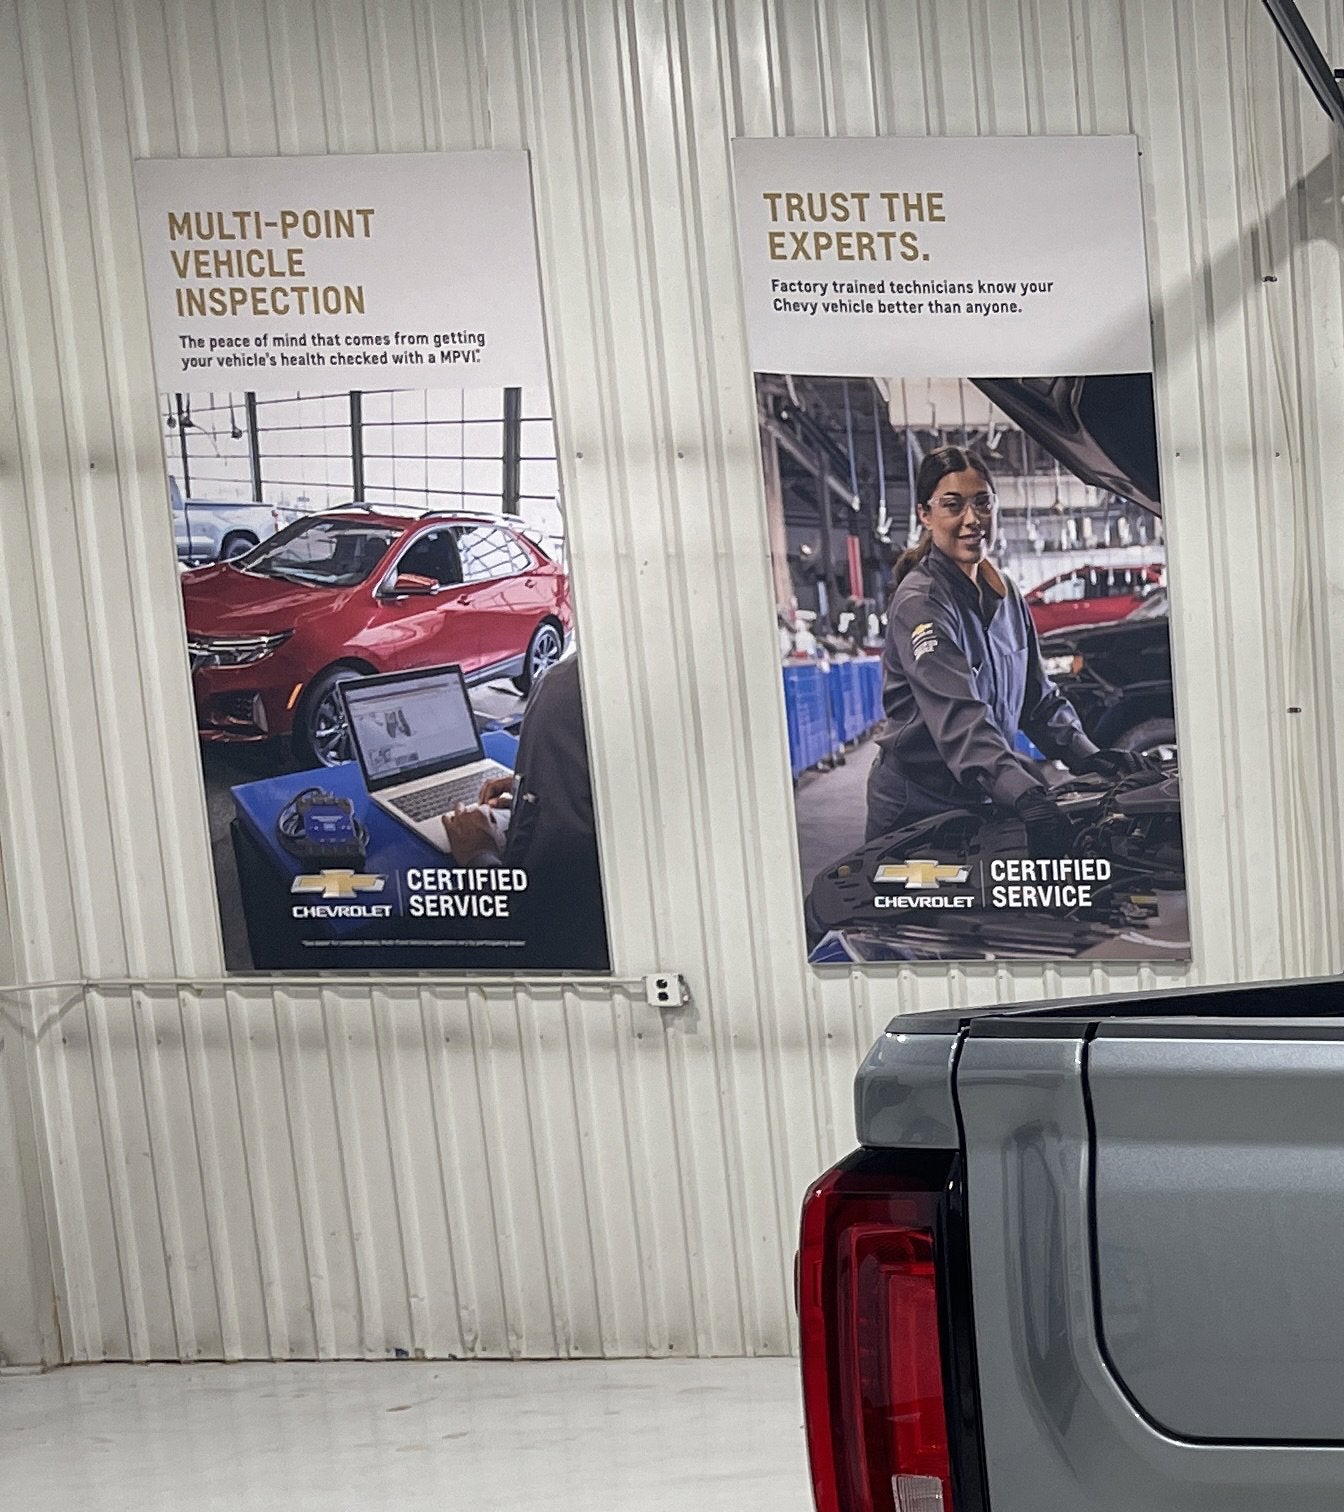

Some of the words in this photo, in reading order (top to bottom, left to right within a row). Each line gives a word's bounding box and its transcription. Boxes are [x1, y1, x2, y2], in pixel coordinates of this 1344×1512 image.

[762, 191, 870, 223] TRUST
[880, 191, 946, 222] THE
[167, 208, 376, 241] MULTI-POINT
[767, 231, 931, 262] EXPERTS.
[170, 249, 305, 279] VEHICLE
[771, 278, 828, 296] Factory
[832, 278, 885, 295] trained
[889, 278, 974, 295] technicians
[978, 279, 1016, 295] know
[1020, 280, 1053, 297] your
[175, 285, 366, 317] INSPECTION
[773, 297, 818, 316] Chevy
[821, 298, 873, 314] vehicle
[877, 299, 924, 314] better
[928, 299, 962, 314] than
[966, 300, 1023, 317] anyone.
[179, 334, 206, 350] The
[209, 335, 250, 353] peace
[254, 332, 269, 349] of
[272, 332, 307, 348] mind
[310, 332, 341, 348] that
[345, 333, 391, 347] comes
[394, 330, 429, 346] from
[433, 330, 486, 348] getting
[181, 353, 213, 371] your
[216, 351, 277, 369] vehicle's
[280, 351, 326, 367] health
[329, 350, 388, 366] checked
[392, 350, 423, 365] with
[427, 351, 436, 364] a
[407, 868, 528, 892] CERTIFIED
[990, 858, 1112, 881] CERTIFIED
[292, 904, 392, 919] CHEVROLET
[410, 895, 510, 918] SERVICE
[873, 895, 975, 908] CHEVROLET
[992, 886, 1092, 908] SERVICE
